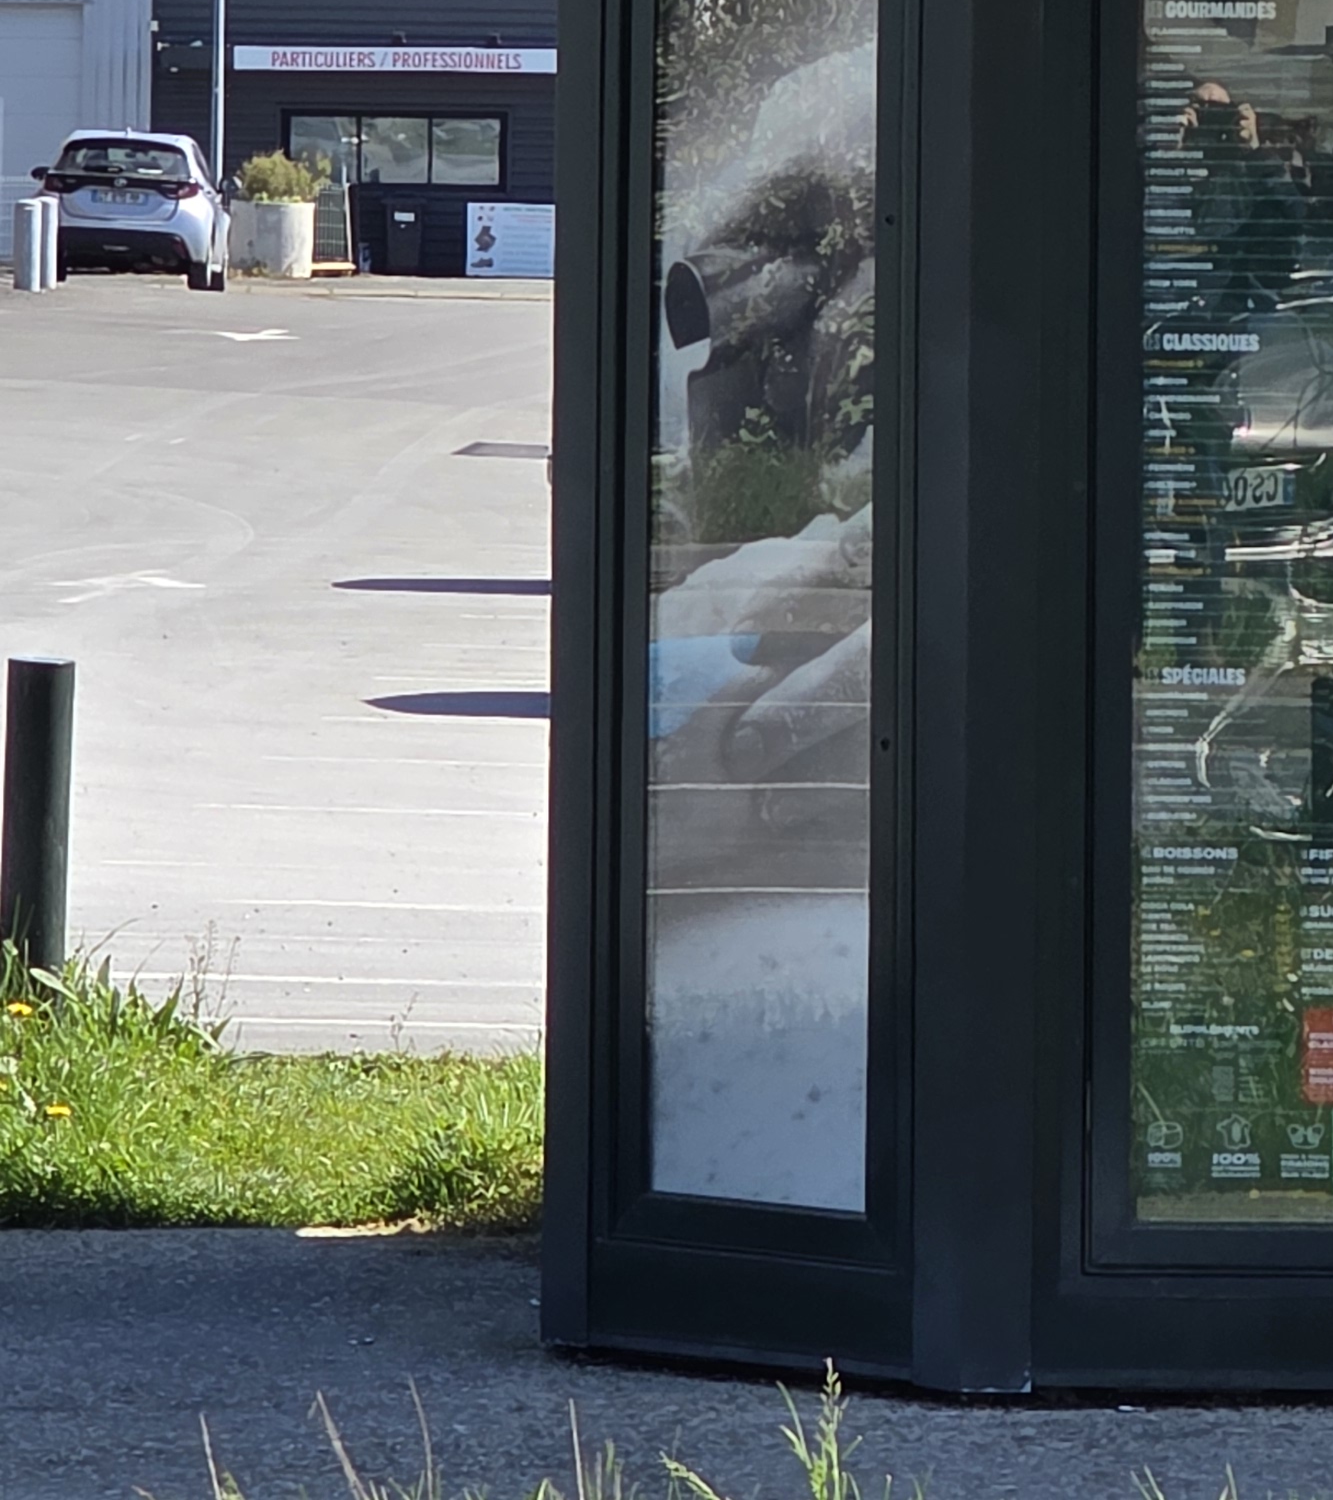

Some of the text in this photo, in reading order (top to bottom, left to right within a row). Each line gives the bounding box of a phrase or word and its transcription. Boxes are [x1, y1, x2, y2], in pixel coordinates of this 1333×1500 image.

[1165, 1, 1276, 19] GOURMANDES
[271, 51, 522, 69] PARTICULIERS / PROFESSIONNELS
[1162, 333, 1260, 351] CLASSIQUES
[1161, 664, 1246, 685] SPÉCIALES
[1153, 846, 1238, 860] BOISSONS
[1213, 1153, 1260, 1164] 100%
